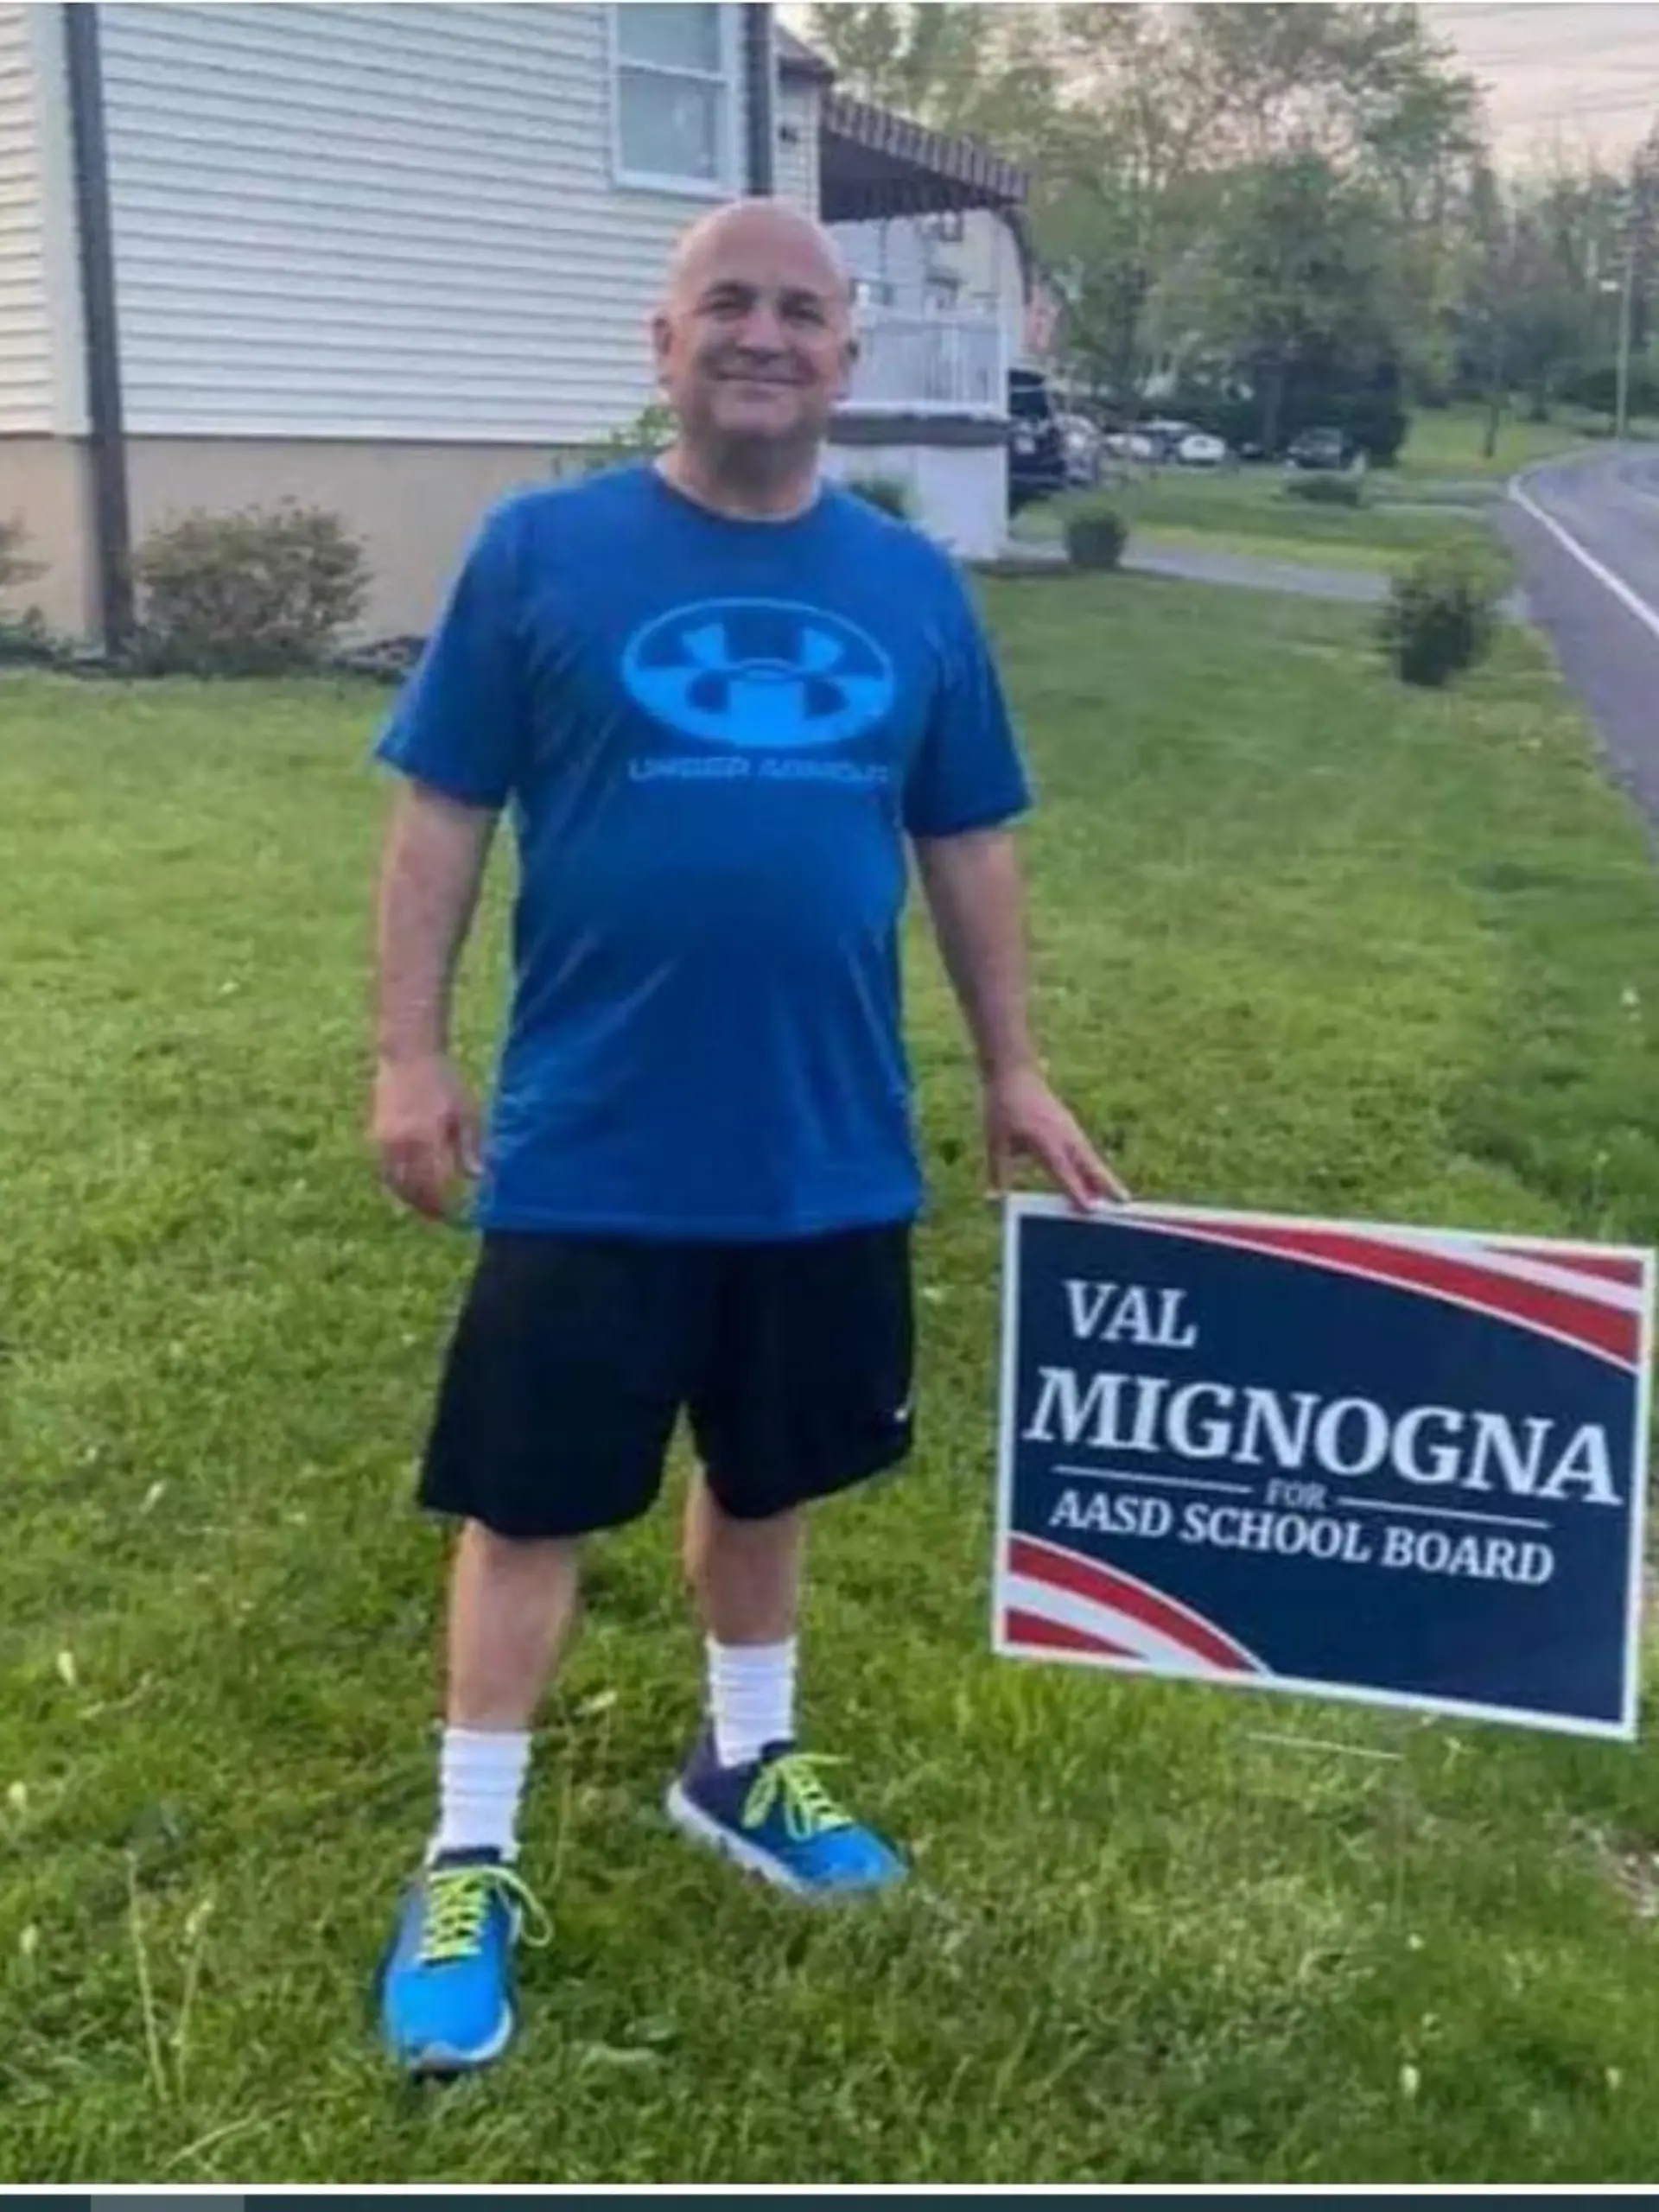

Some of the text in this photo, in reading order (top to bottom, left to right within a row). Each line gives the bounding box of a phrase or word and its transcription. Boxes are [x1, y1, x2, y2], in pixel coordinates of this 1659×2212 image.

[1065, 1278, 1198, 1349] VAL
[1022, 1365, 1624, 1506] MIGNOGNA
[1264, 1477, 1327, 1511] FOR
[1049, 1489, 1554, 1585] AASD SCHOOL BOARD
